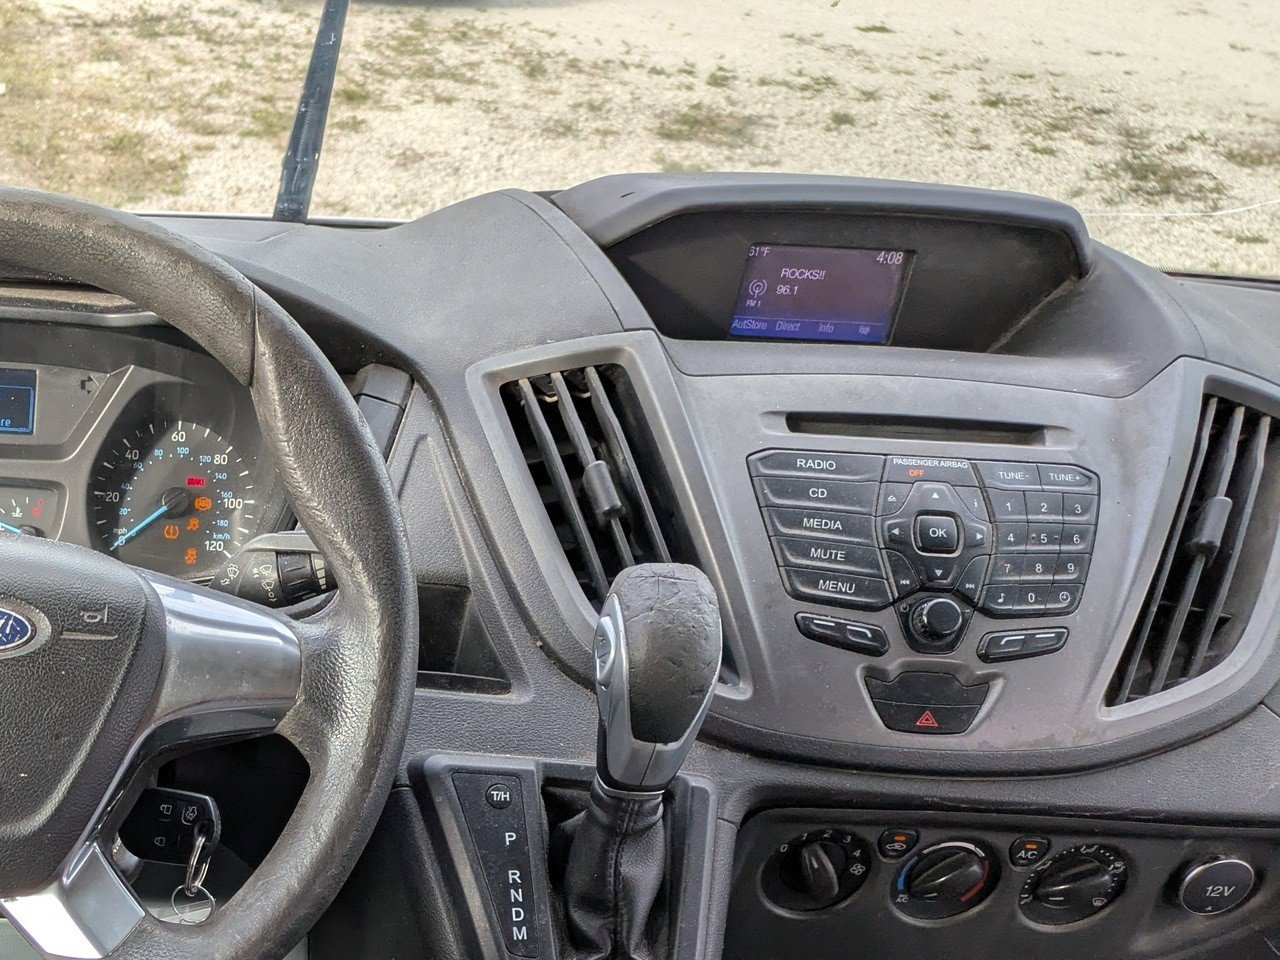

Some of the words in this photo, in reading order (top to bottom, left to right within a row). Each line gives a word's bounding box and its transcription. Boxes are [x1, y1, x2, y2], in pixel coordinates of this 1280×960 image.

[876, 251, 903, 265] 4:08
[780, 267, 826, 280] ROCKS!!
[776, 284, 798, 295] 96.1
[775, 321, 801, 332] Direct
[818, 323, 835, 334] Info
[171, 431, 186, 442] 60
[125, 449, 139, 460] 40
[213, 454, 228, 465] 80
[133, 461, 143, 469] 60
[796, 458, 837, 470] RADIO
[893, 457, 940, 468] PASSENGER
[940, 460, 968, 469] AIRBAG
[215, 472, 228, 480] 140
[908, 468, 925, 477] OFF
[998, 470, 1030, 481] TUNE-
[1049, 472, 1082, 484] TUNE+
[105, 491, 120, 502] 20
[809, 487, 828, 499] CD
[223, 499, 243, 509] 100
[1005, 502, 1012, 512] 1
[1040, 502, 1048, 513] 2
[1074, 503, 1083, 514] 3
[216, 519, 229, 527] 180
[802, 517, 843, 531] MEDIA
[213, 532, 231, 540] km/h
[928, 526, 948, 539] OK
[1006, 533, 1015, 544] 4
[1040, 533, 1048, 544] 5
[1072, 534, 1081, 545] 6
[204, 541, 224, 551] 120
[810, 548, 846, 561] MUTE
[1003, 563, 1012, 574] 7
[1034, 562, 1043, 573] 8
[1067, 562, 1075, 574] 9
[818, 579, 856, 594] MENU
[1027, 592, 1036, 603] 0
[490, 790, 510, 802] T/H
[505, 832, 517, 845] P
[802, 832, 808, 840] 1
[823, 829, 833, 838] 2
[842, 835, 852, 843] 3
[780, 843, 789, 853] 0
[852, 849, 861, 858] 4
[1017, 850, 1038, 859] A/C
[508, 869, 522, 883] R
[510, 889, 523, 902] N
[1205, 885, 1236, 897] 12V
[511, 908, 525, 921] D
[513, 926, 527, 940] M
